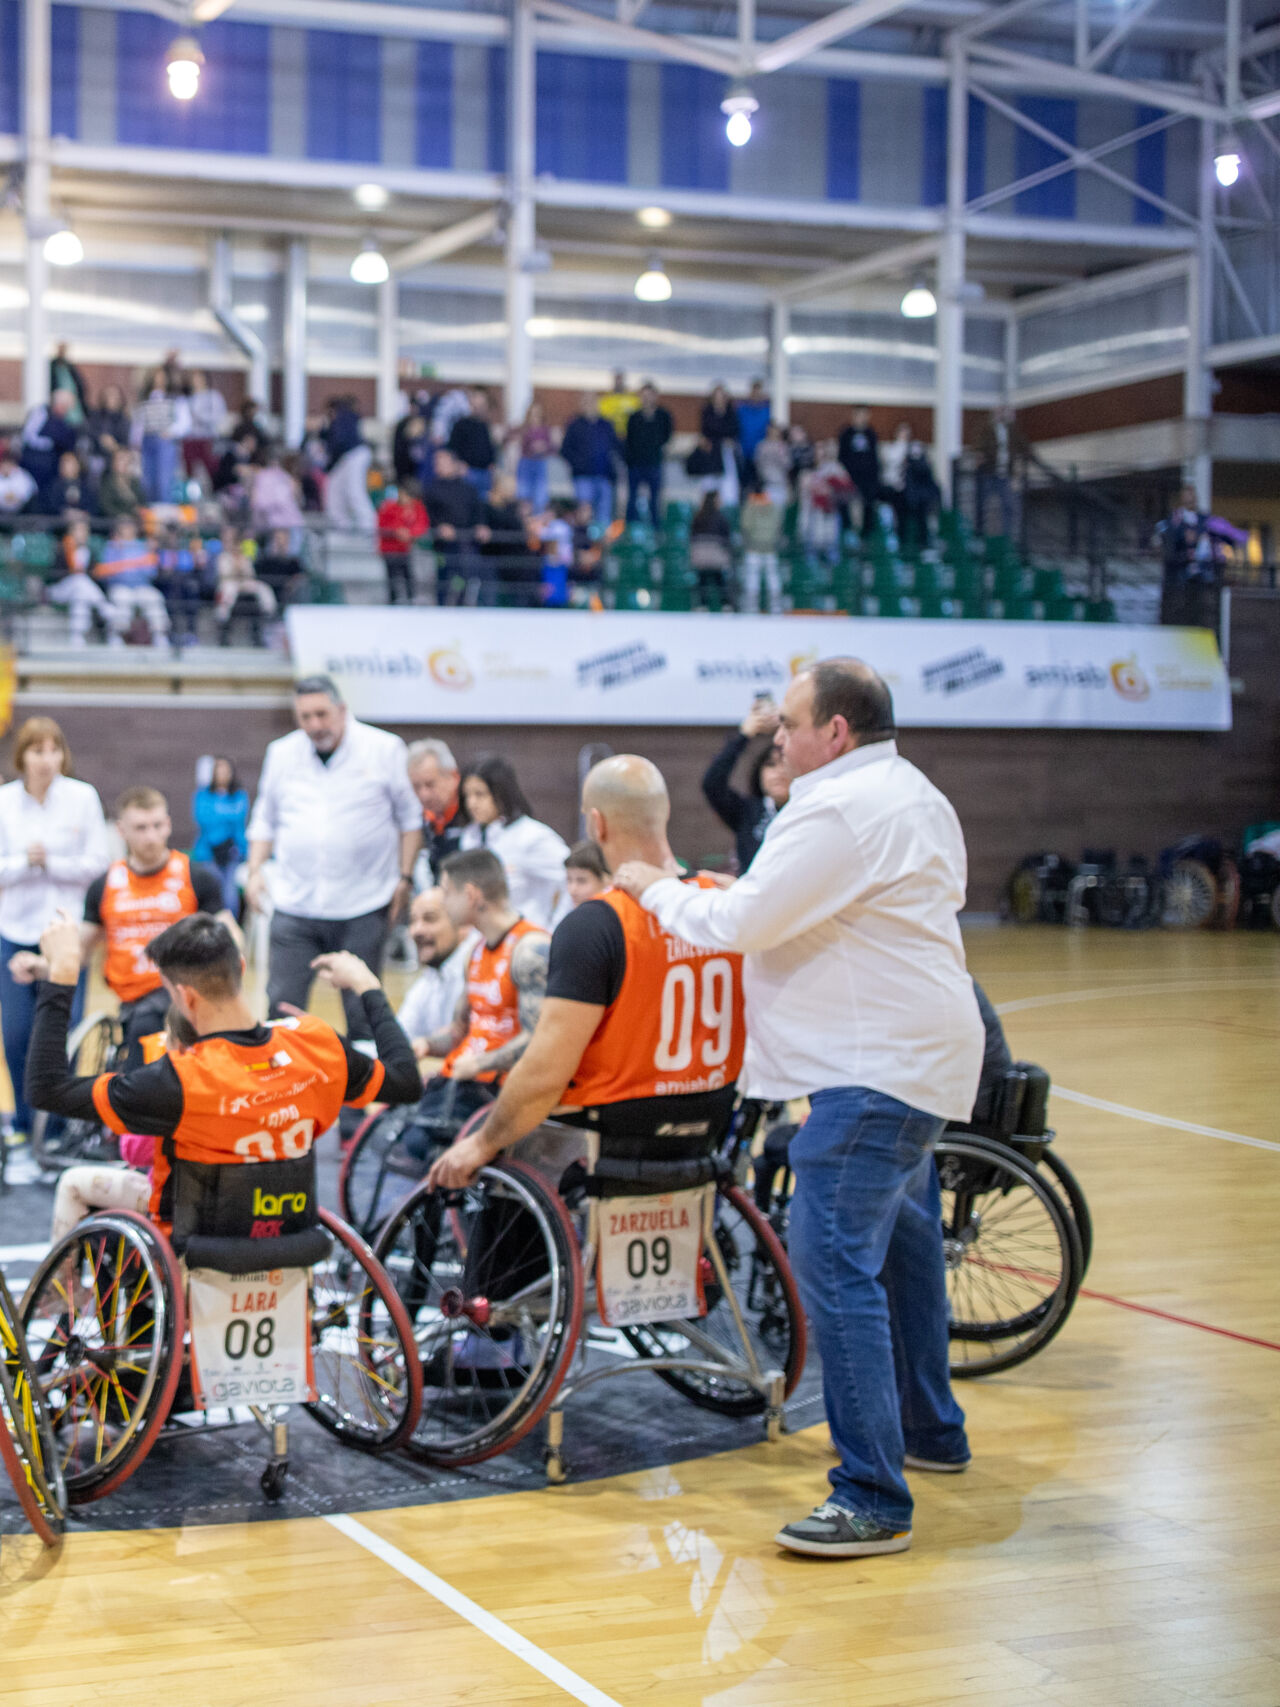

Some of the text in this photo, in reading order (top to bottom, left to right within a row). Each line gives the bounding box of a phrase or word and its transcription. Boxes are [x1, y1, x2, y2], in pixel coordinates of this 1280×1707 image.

[654, 957, 733, 1071] 09
[610, 1208, 690, 1235] ZARZUELA
[627, 1236, 671, 1279] 09
[231, 1291, 278, 1314] LARA
[224, 1317, 275, 1360] 08
[212, 1377, 296, 1402] gaviota
